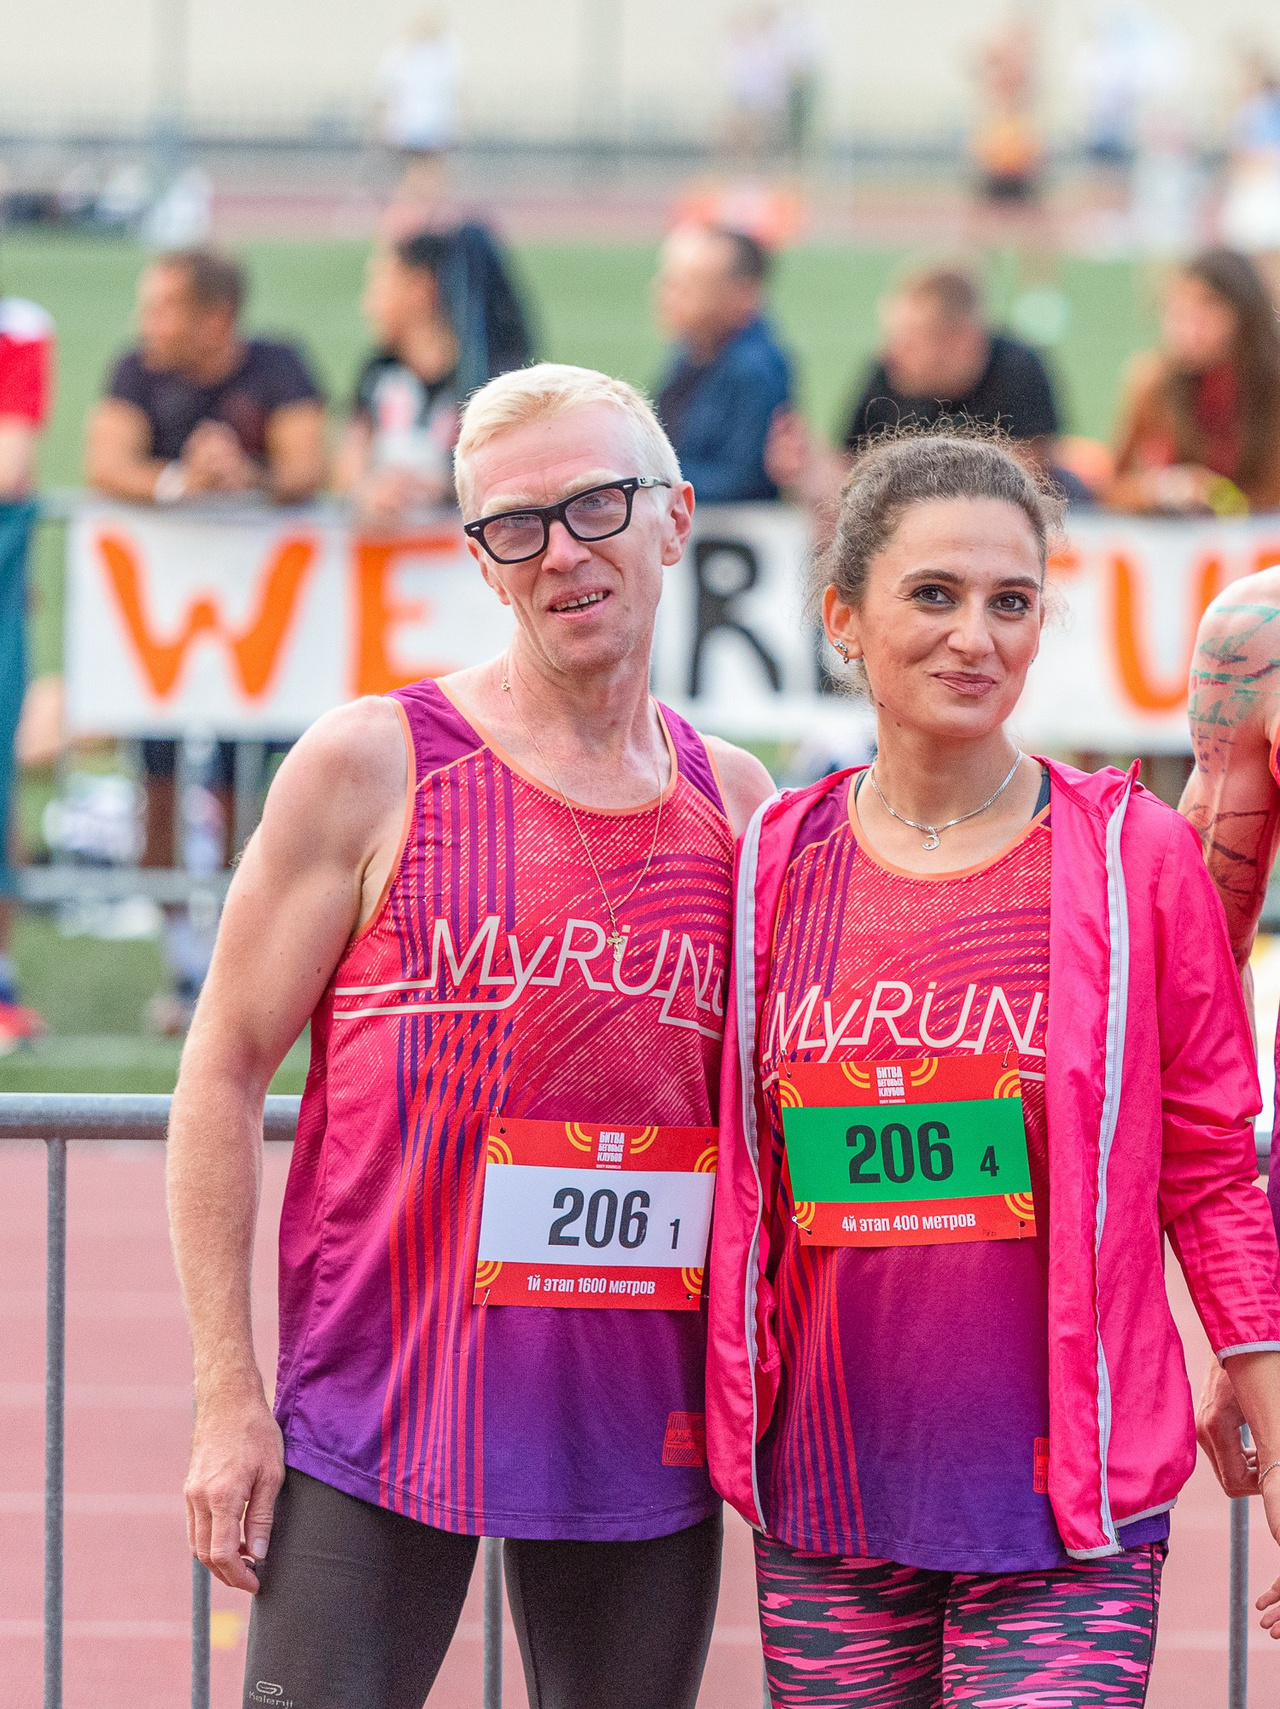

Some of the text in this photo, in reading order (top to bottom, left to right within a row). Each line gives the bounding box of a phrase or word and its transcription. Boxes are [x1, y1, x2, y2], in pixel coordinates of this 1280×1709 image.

[96, 532, 462, 704] WE
[845, 1120, 1000, 1184] 206 4
[548, 1187, 681, 1250] 206 1
[841, 1213, 976, 1232] 4й этап 400 метров
[526, 1275, 656, 1297] 1й этап 1600 метров
